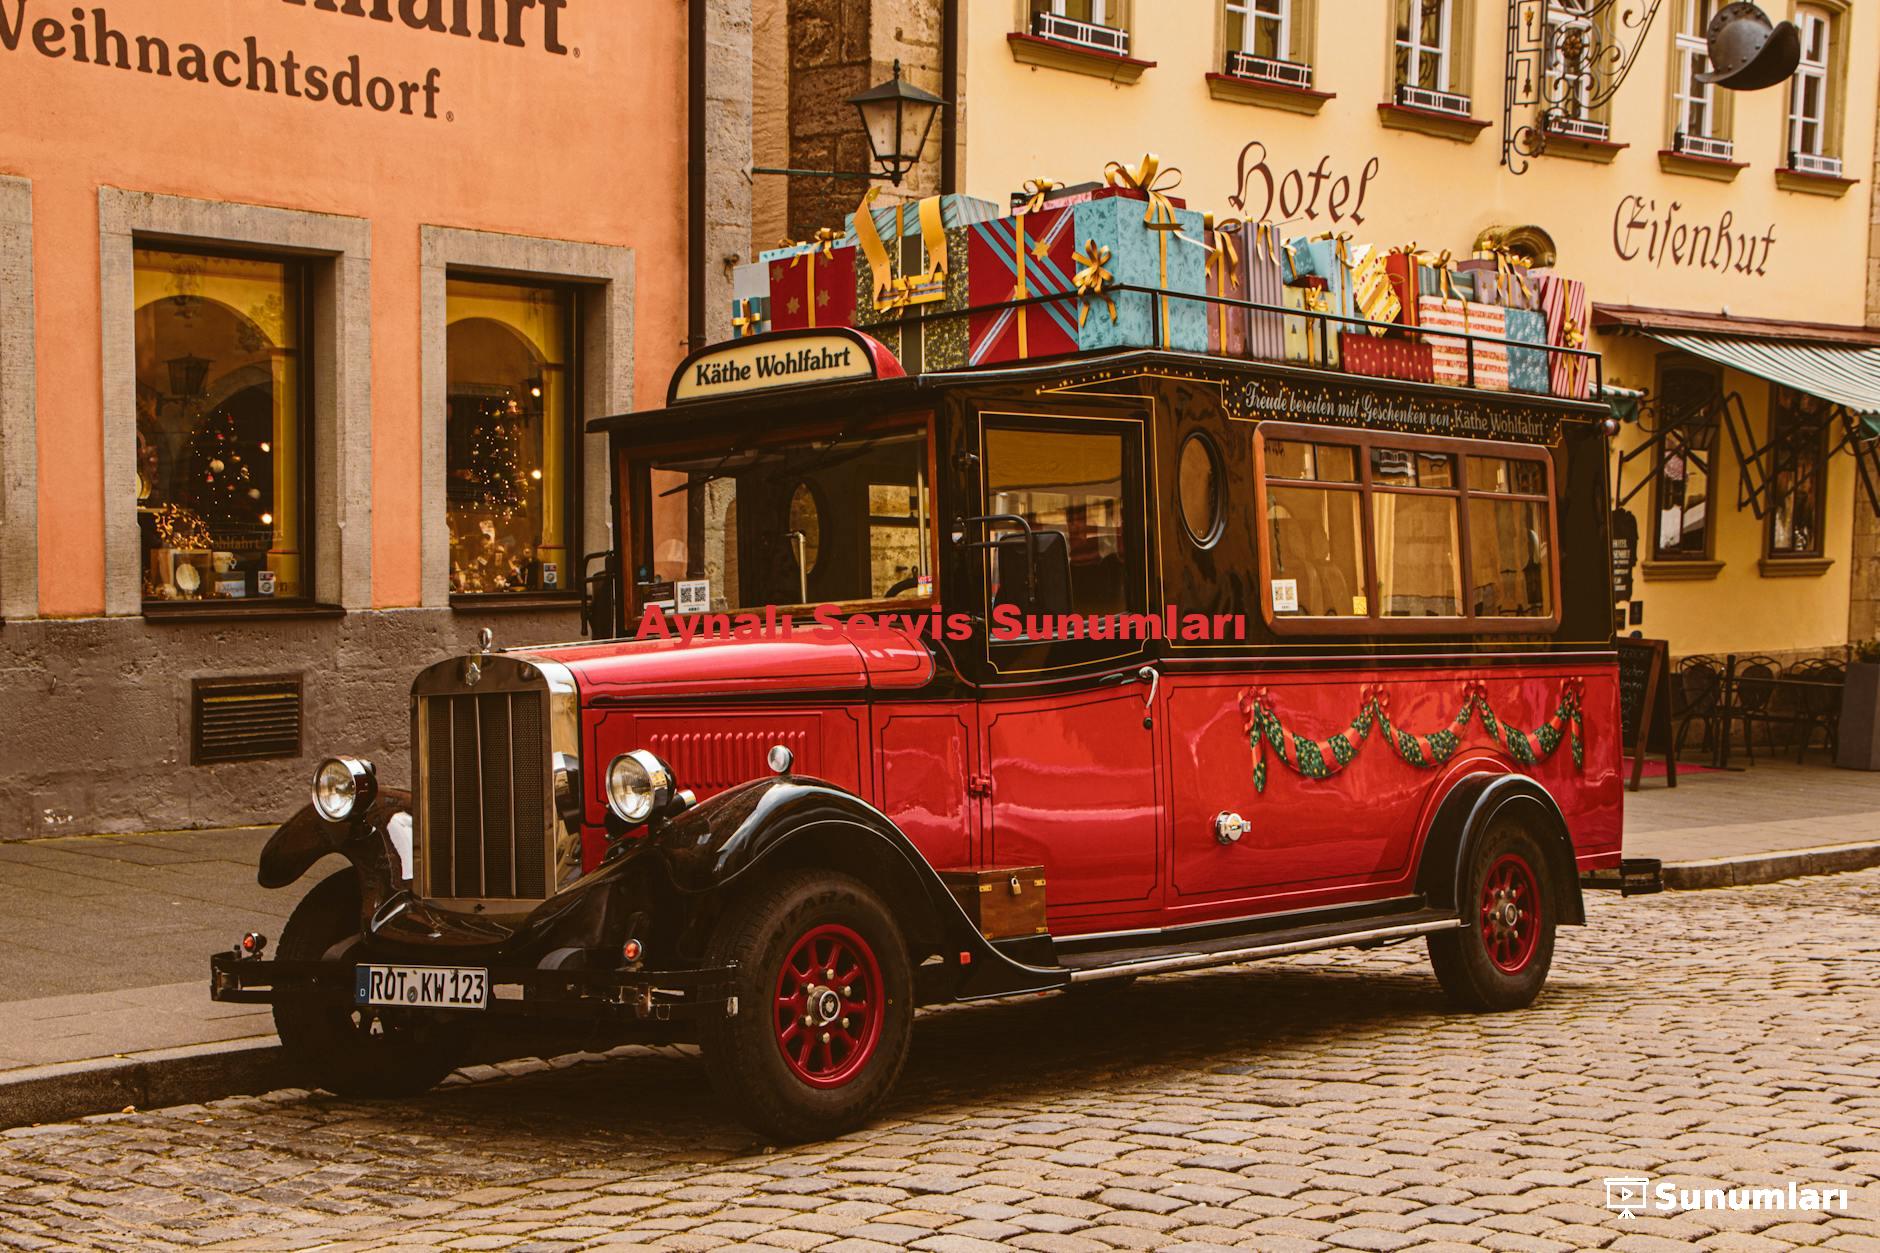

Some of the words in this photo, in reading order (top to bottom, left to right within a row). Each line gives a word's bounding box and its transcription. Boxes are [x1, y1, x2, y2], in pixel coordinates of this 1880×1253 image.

[1228, 141, 1379, 226] Hotel
[696, 360, 751, 386] Käthe
[755, 347, 851, 378] Wohlfahrt
[1245, 381, 1287, 411] Freude
[1289, 391, 1335, 415] bereiten
[1337, 398, 1360, 417] mit
[1361, 394, 1427, 425] Geschenken
[1429, 412, 1450, 427] von
[1453, 409, 1489, 431] Käthe
[1490, 413, 1545, 436] Wohlfahrt
[360, 988, 366, 997] D
[370, 970, 407, 1000] ROT
[421, 973, 445, 1002] KW
[449, 973, 484, 1003] 123
